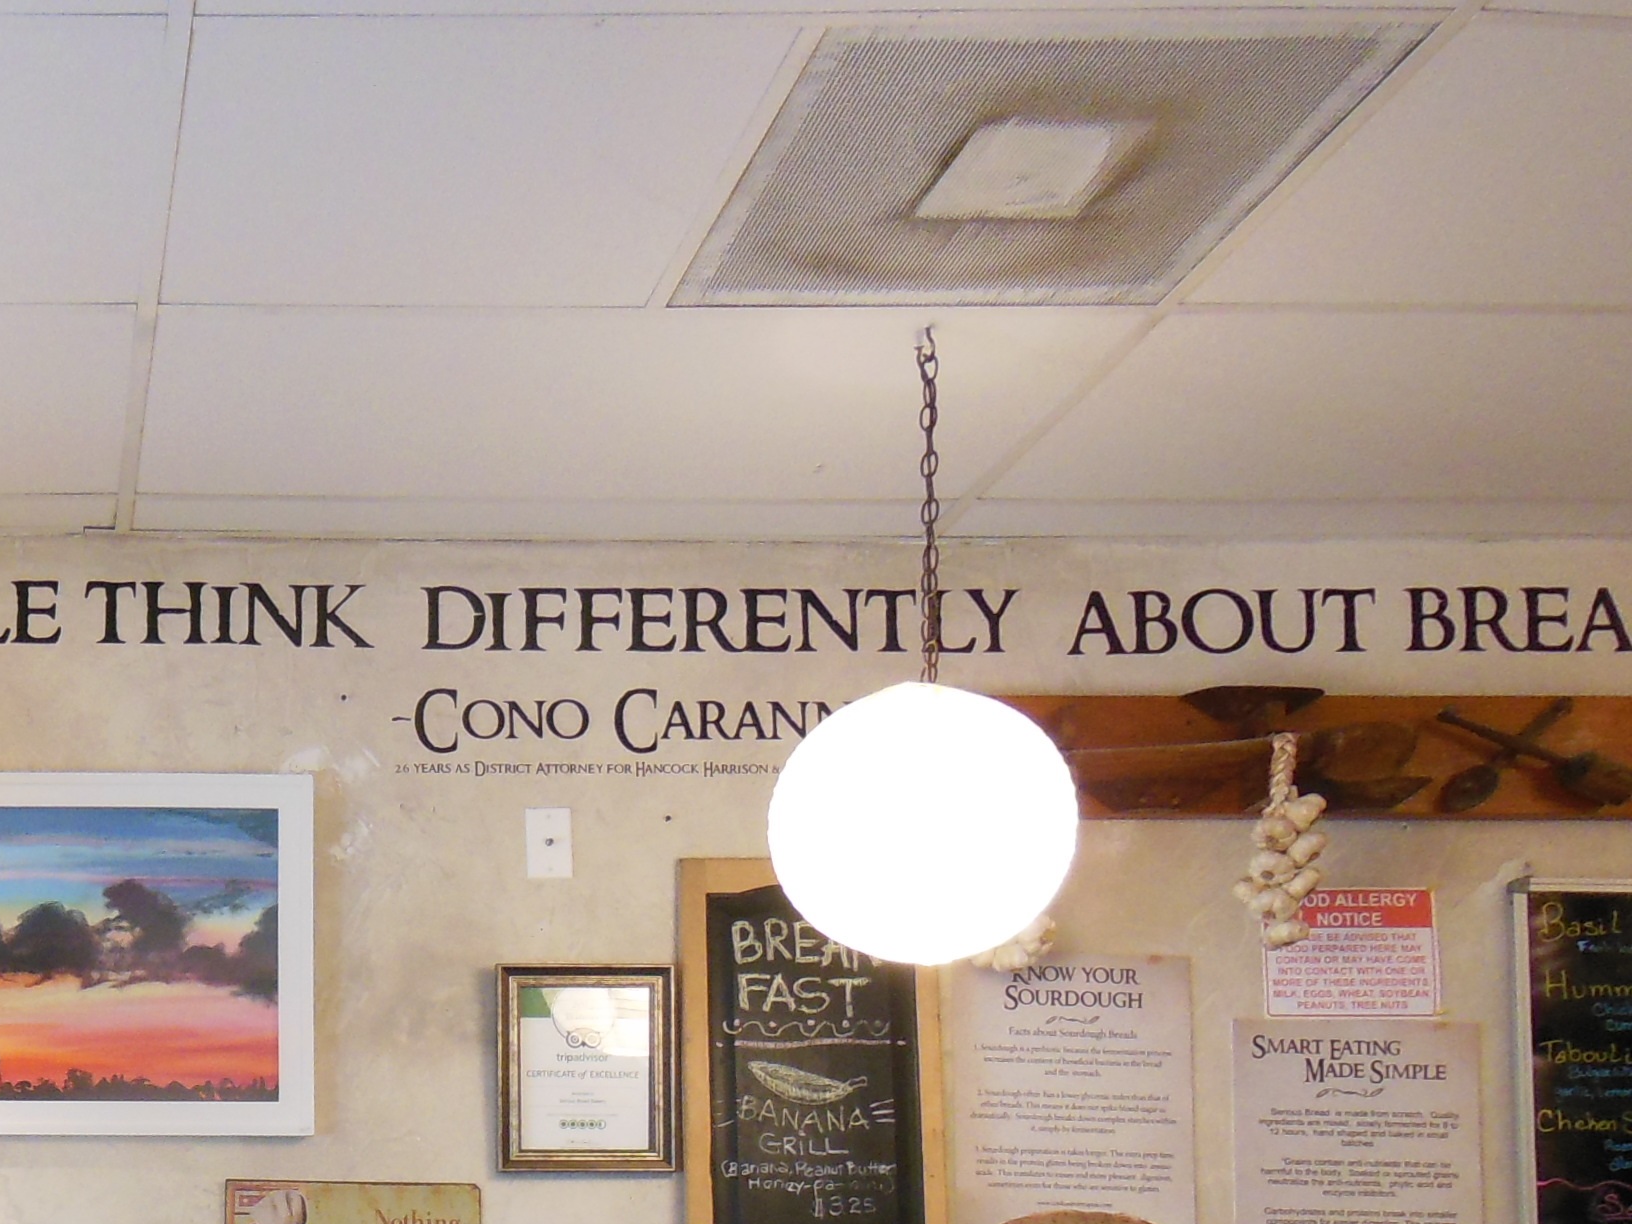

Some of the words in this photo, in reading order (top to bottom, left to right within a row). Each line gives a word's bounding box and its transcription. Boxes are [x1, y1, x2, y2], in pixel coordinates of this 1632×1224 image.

[84, 581, 375, 649] THINK
[420, 585, 1021, 654] DIFFERENTLY
[1066, 588, 1376, 656] ABOUT
[414, 762, 452, 774] YEARS
[455, 763, 471, 774] AS
[474, 761, 531, 777] DISTRICT
[536, 762, 603, 776] ATTORNEY
[606, 763, 633, 775] FOR
[635, 761, 700, 777] HANCOCK
[703, 761, 769, 777] HARRISON
[1335, 893, 1418, 907] ALLERGY
[1317, 912, 1383, 926] NOTICE
[1081, 967, 1141, 986] YOUR
[737, 972, 872, 1018] FAST
[1003, 985, 1144, 1011] SOURDOUGH
[556, 1052, 609, 1063] tripadvisor
[1251, 1034, 1325, 1059] SMART
[1330, 1039, 1402, 1060] EATING
[526, 1070, 576, 1078] CERTIFICATE
[577, 1069, 587, 1080] of
[589, 1070, 640, 1079] EXCELLENCE
[1304, 1058, 1366, 1083] MADE
[1369, 1060, 1447, 1084] SIMPLE
[737, 1095, 870, 1133] BANANA
